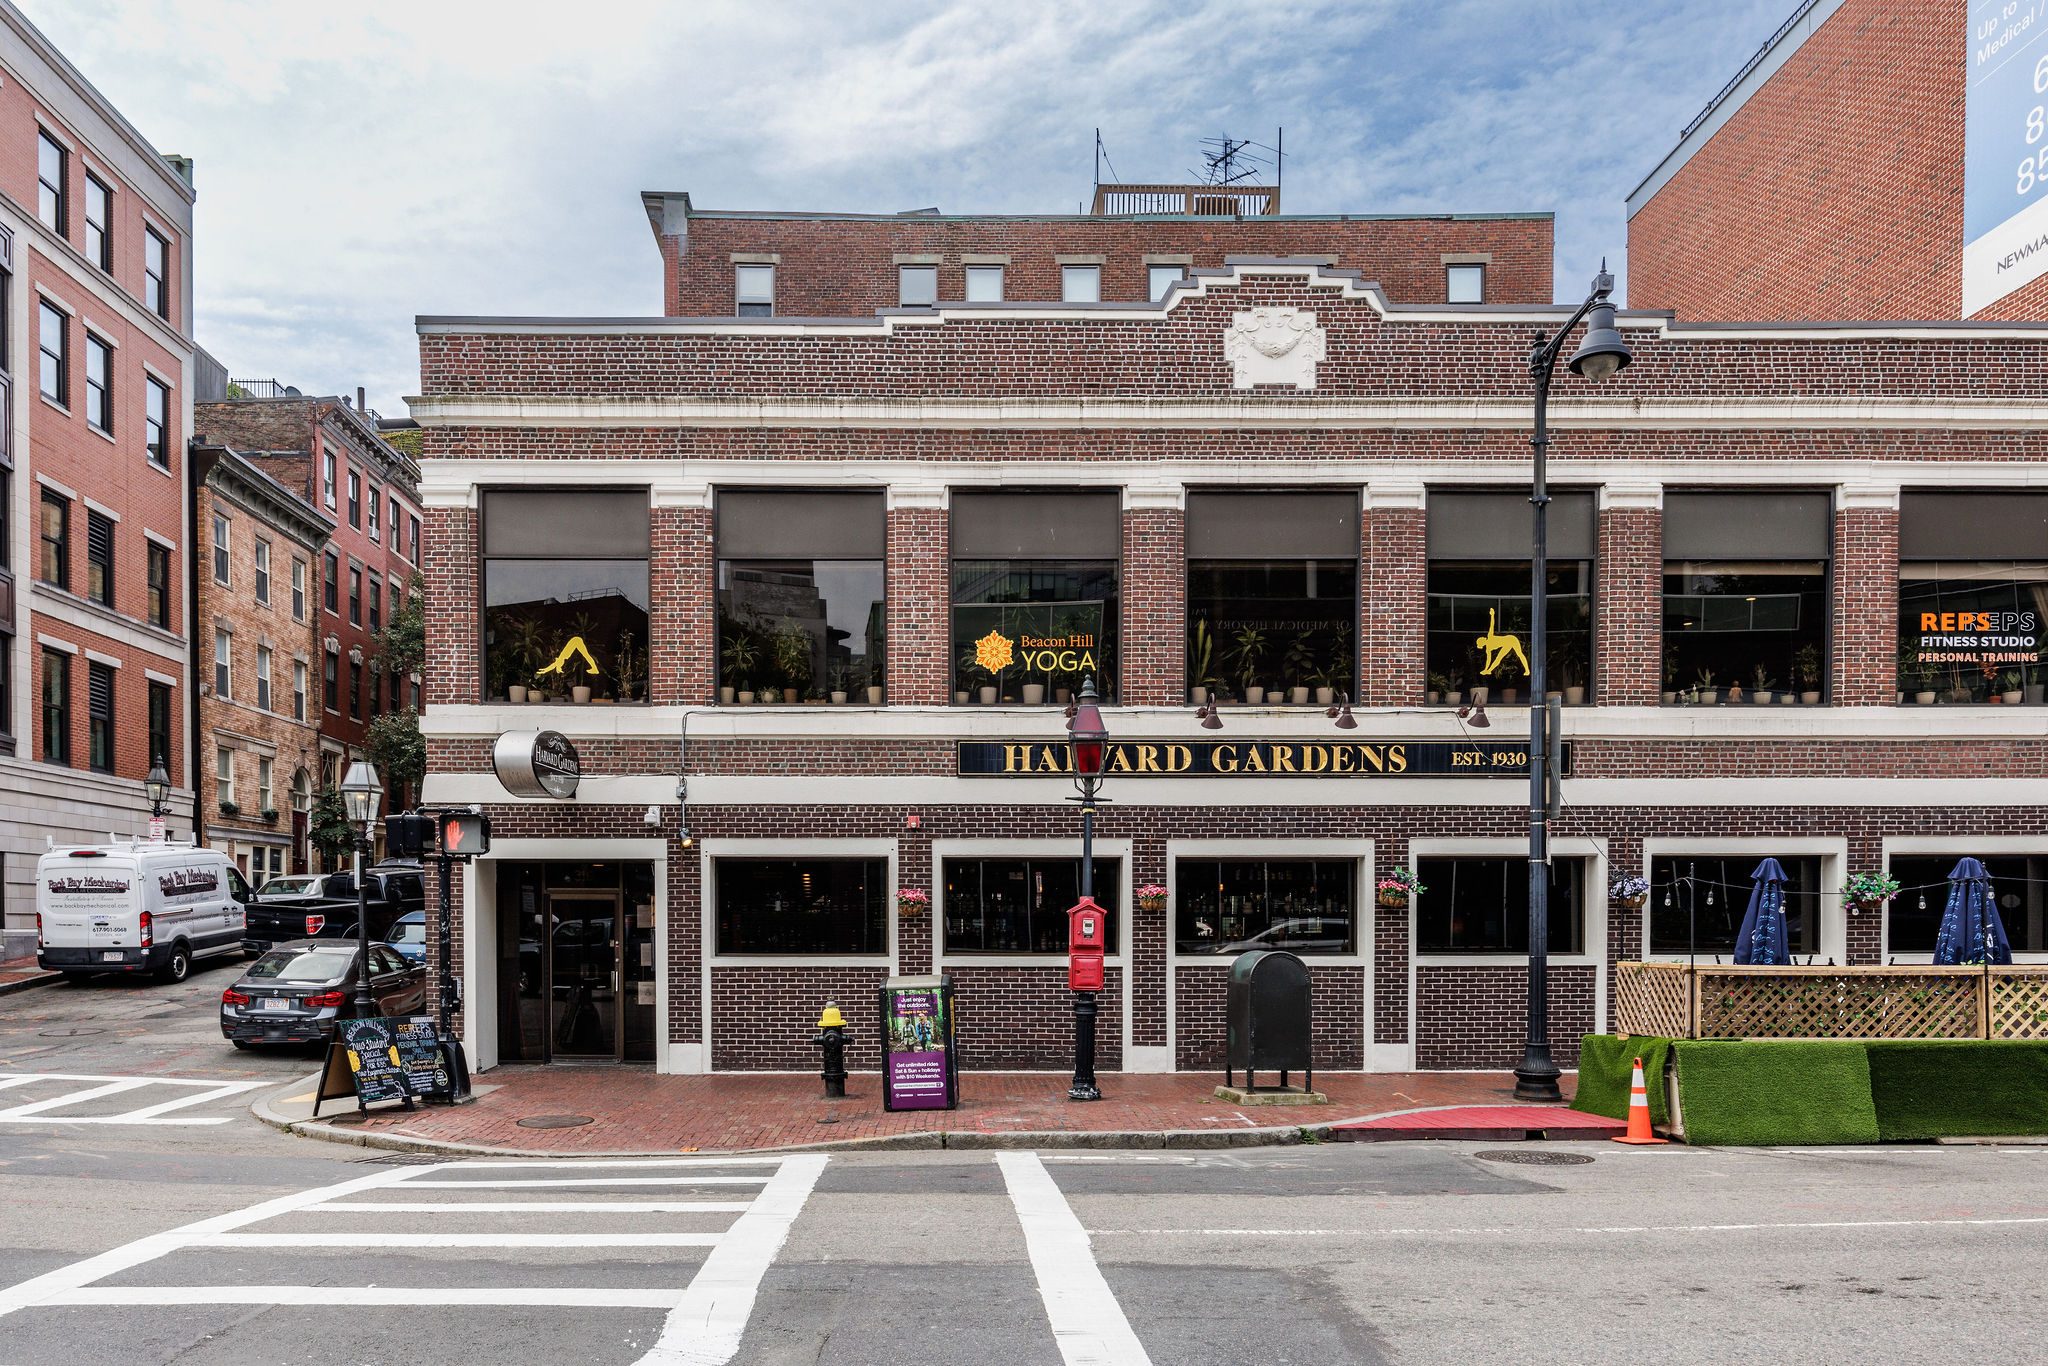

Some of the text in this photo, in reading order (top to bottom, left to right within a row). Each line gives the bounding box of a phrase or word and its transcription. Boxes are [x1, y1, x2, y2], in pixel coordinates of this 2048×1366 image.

[1978, 1, 2017, 40] Up to
[1977, 6, 2034, 66] Medical
[1021, 634, 1094, 647] Beacon Hill
[1921, 636, 2036, 647] FITNESS STUDIO
[1021, 650, 1096, 671] YOGA
[1918, 652, 2038, 662] PERSONAL TRAINING
[1212, 744, 1407, 772] GARDENS
[1451, 751, 1527, 766] EST. 1930
[67, 877, 83, 888] Bay
[84, 876, 131, 890] Mechanical
[346, 1020, 366, 1042] BEACON
